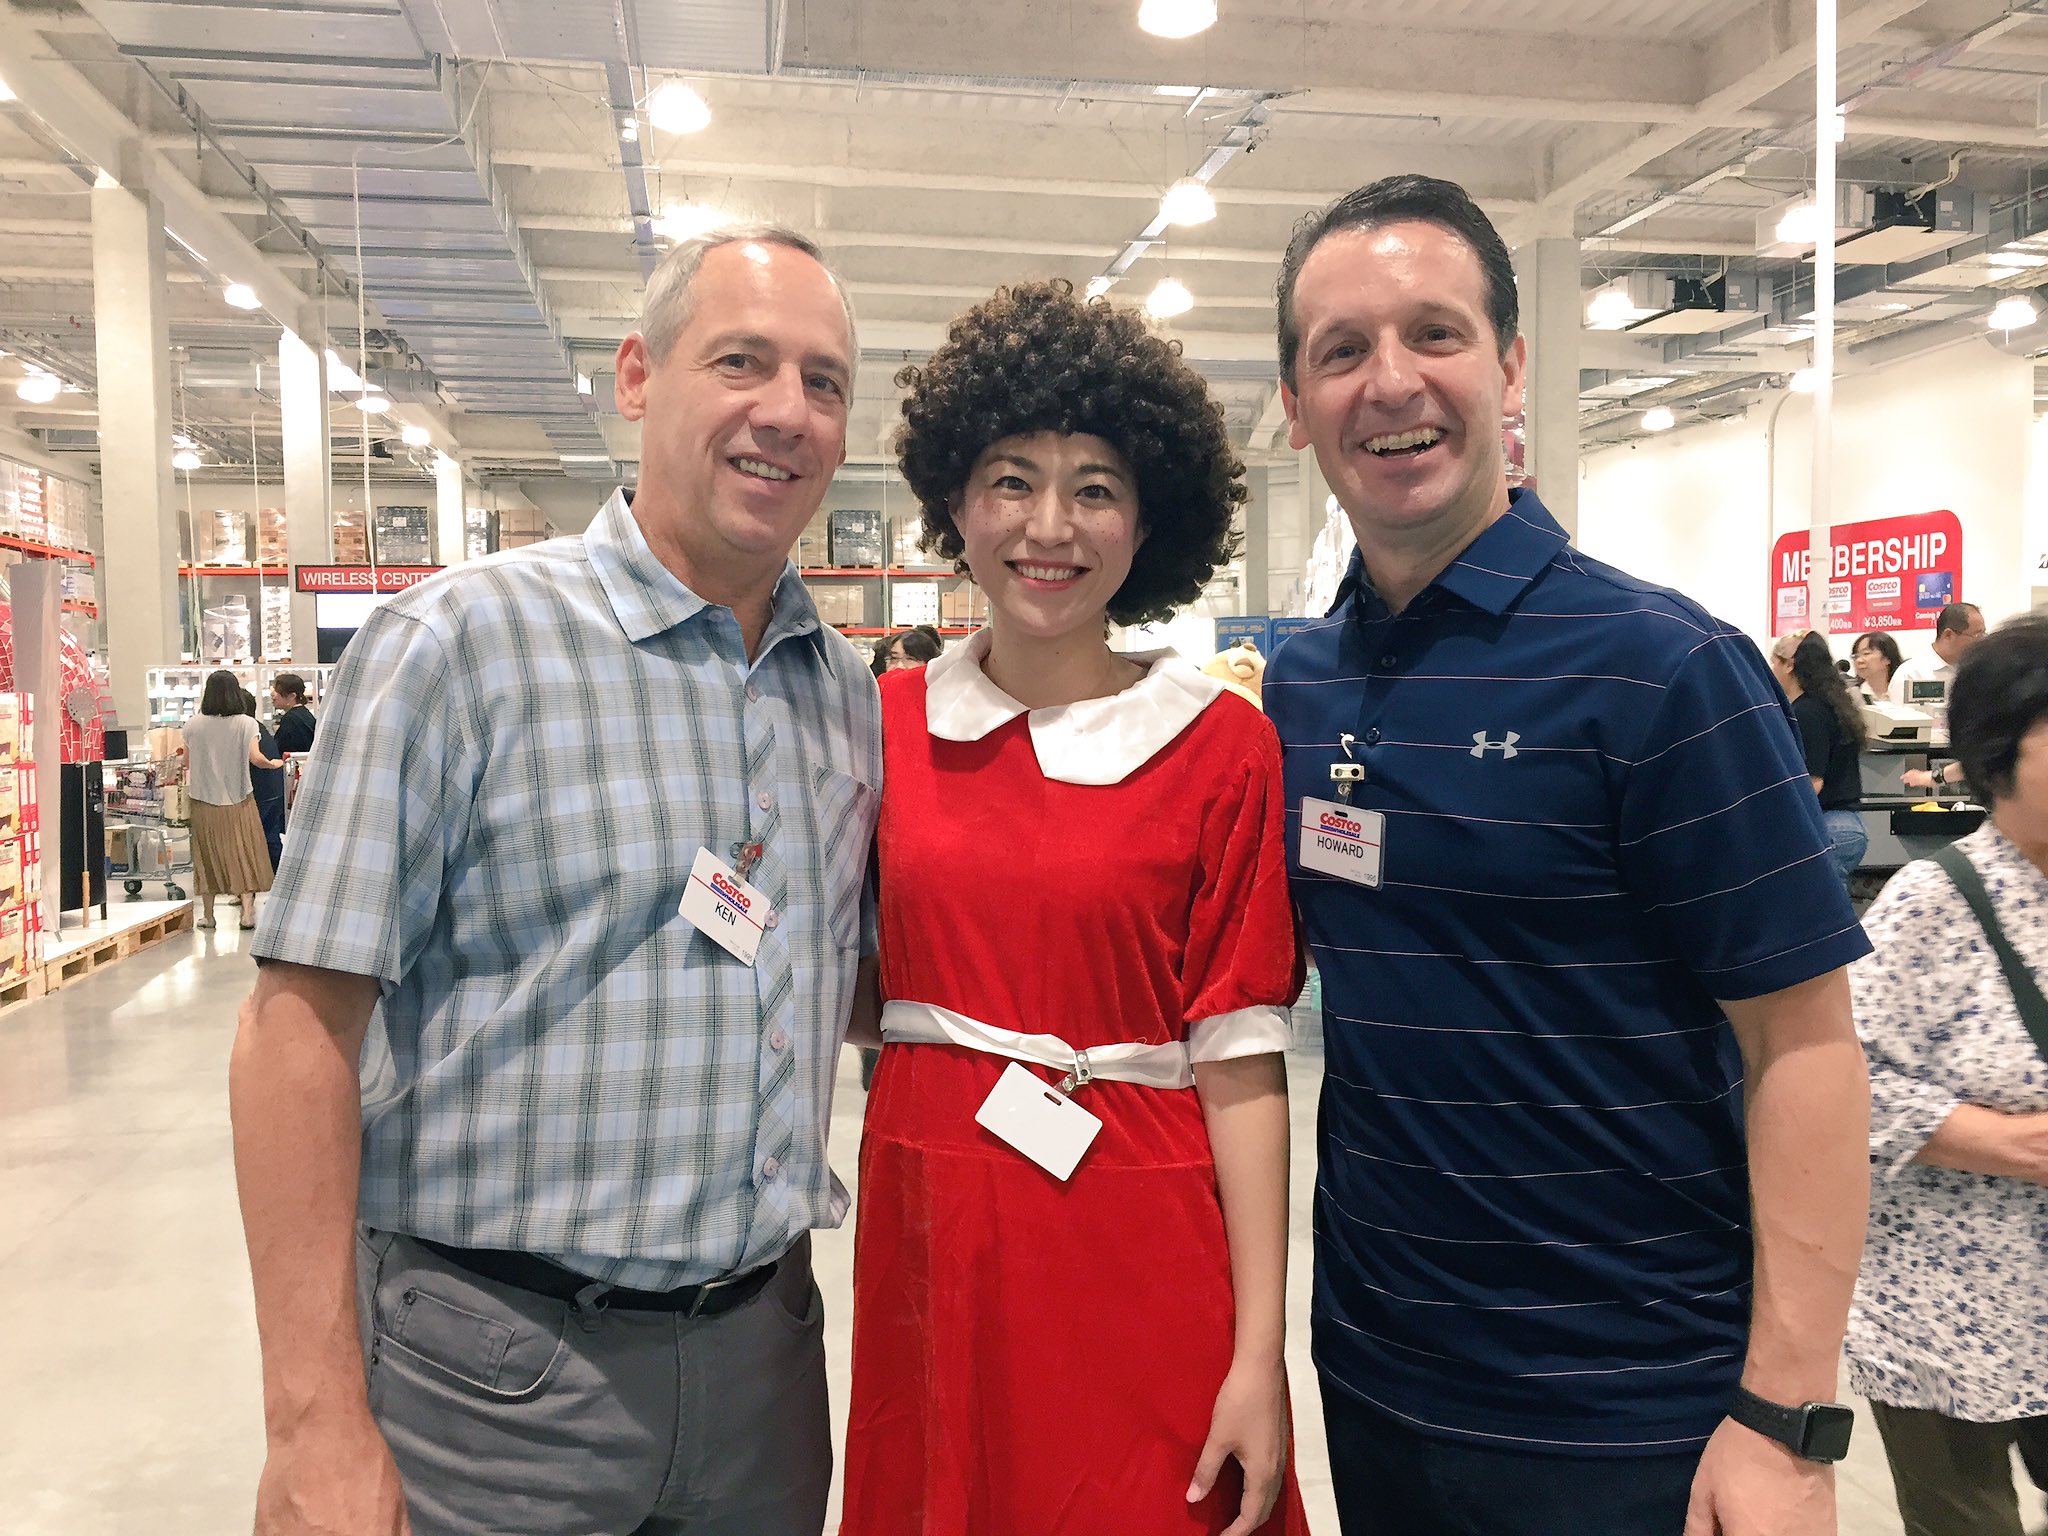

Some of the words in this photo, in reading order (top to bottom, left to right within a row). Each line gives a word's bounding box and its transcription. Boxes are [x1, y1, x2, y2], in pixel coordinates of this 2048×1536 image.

[1782, 531, 1947, 583] MEBERSHIP
[302, 572, 378, 586] WIRELESS
[382, 571, 439, 586] CENTE
[1868, 581, 1898, 591] COSTCO
[1320, 812, 1362, 832] COSTCO
[1317, 835, 1364, 859] HOWARD
[712, 872, 751, 908] COSTCO
[715, 901, 737, 926] KEN
